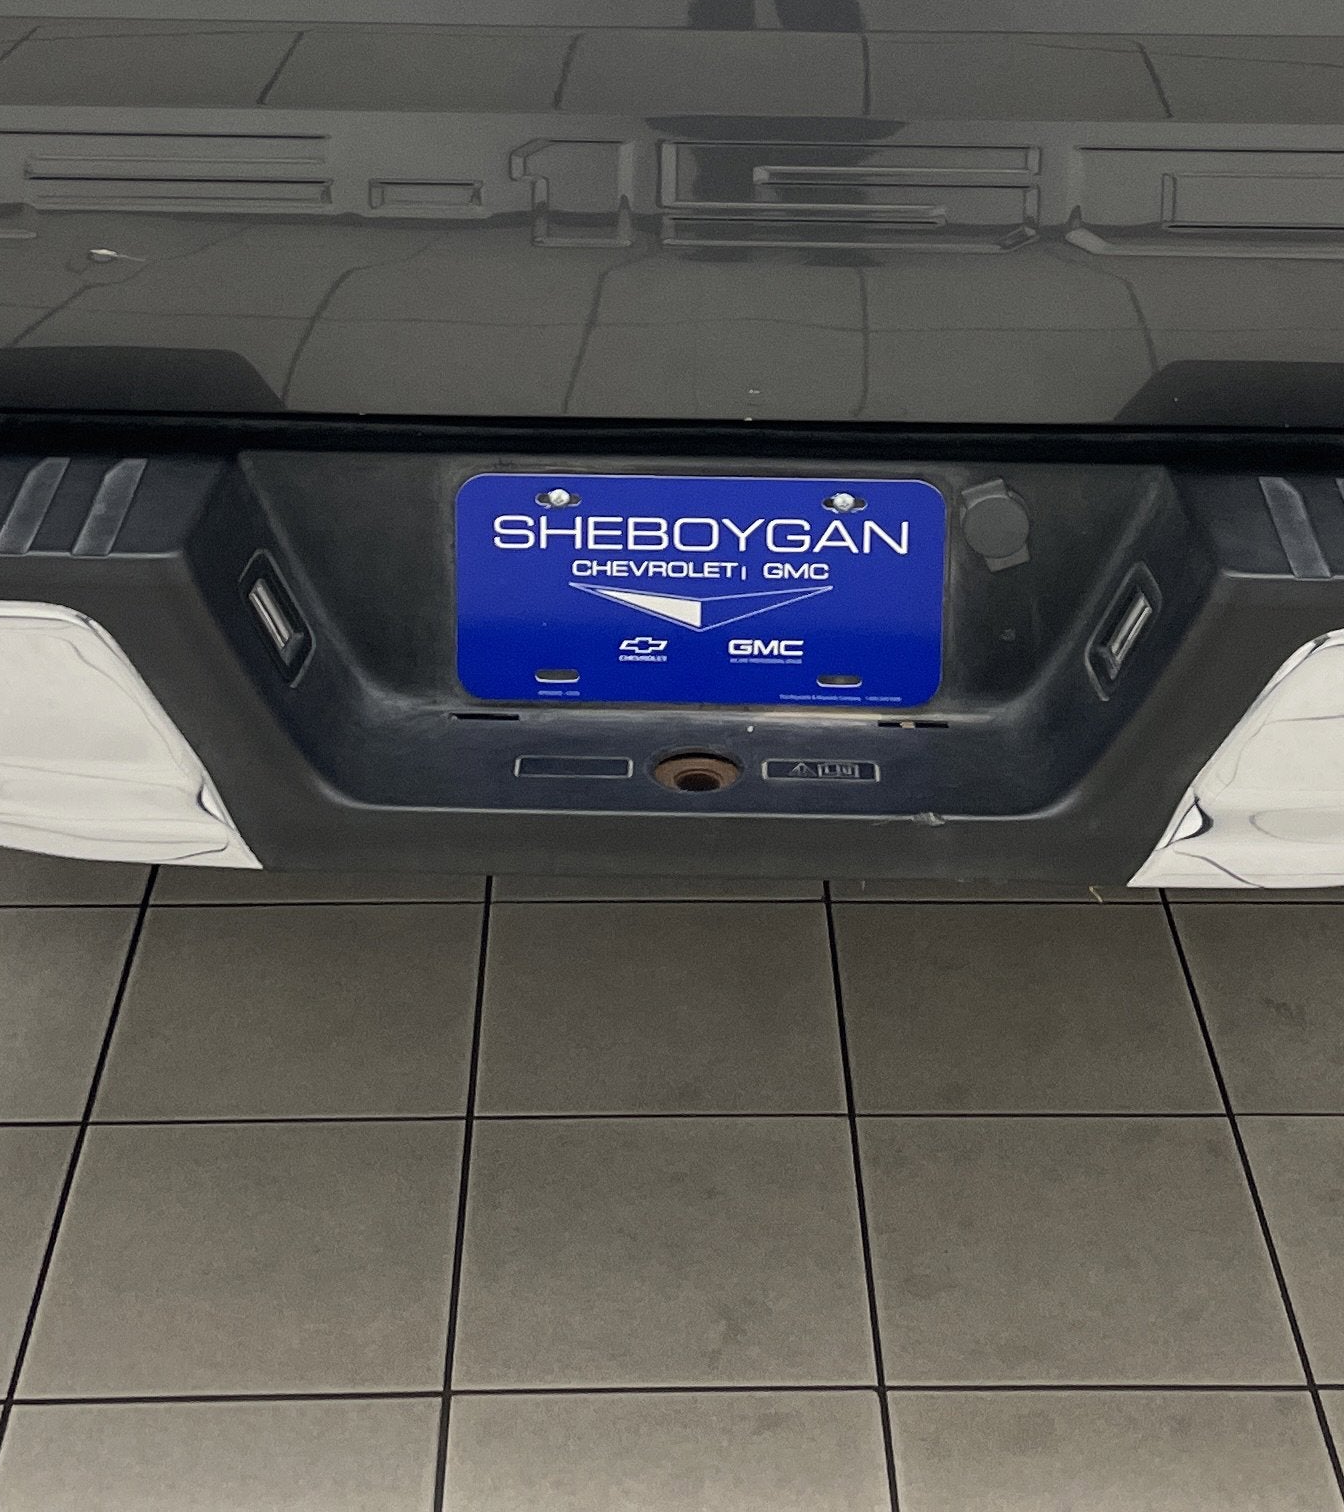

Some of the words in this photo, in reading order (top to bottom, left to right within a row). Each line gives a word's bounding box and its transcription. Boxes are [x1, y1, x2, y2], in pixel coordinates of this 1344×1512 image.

[493, 514, 909, 555] SHEBOYGAN
[571, 559, 738, 579] CHEVROLET
[763, 563, 830, 580] GMC
[728, 639, 804, 656] GMC
